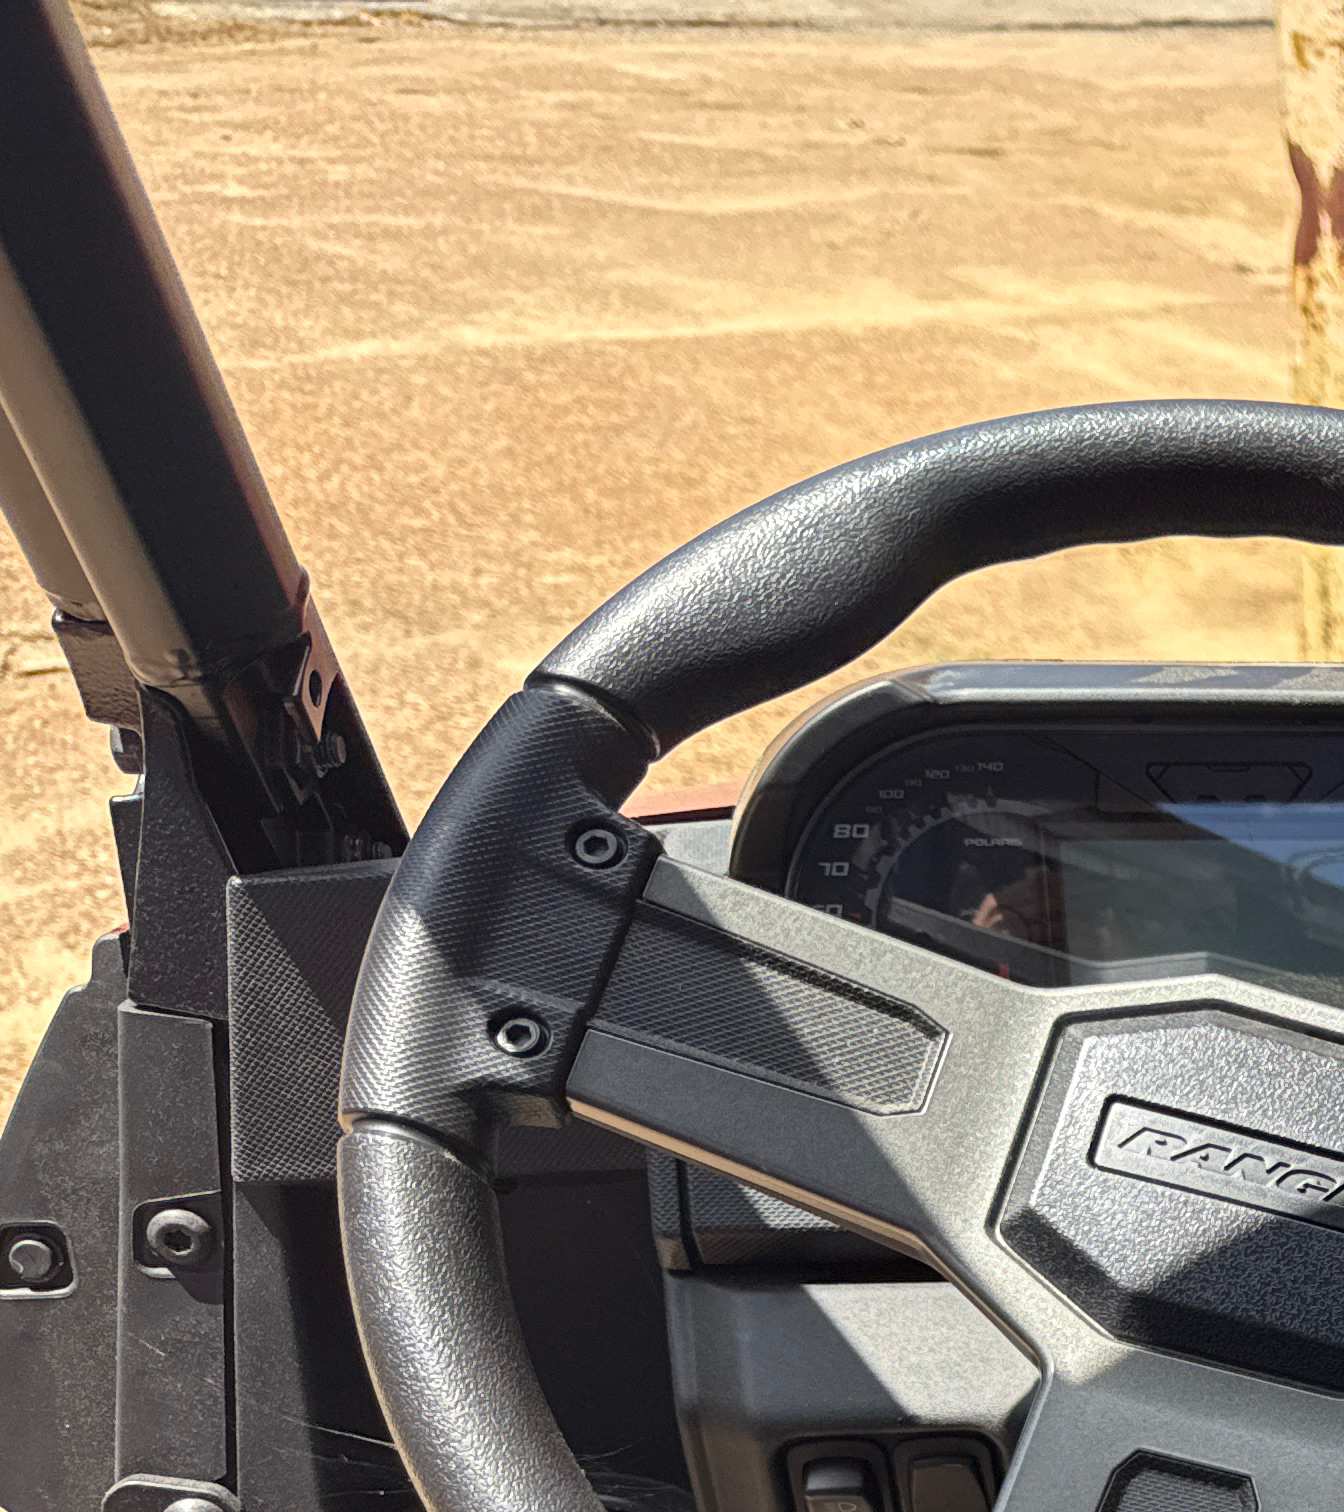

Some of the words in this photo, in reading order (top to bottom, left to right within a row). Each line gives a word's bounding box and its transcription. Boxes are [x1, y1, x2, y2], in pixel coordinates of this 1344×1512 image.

[977, 761, 1004, 772] 140
[925, 769, 950, 780] 120
[878, 789, 905, 800] 100
[832, 823, 871, 839] 80
[963, 837, 1024, 848] POLARIS
[819, 861, 850, 877] 70
